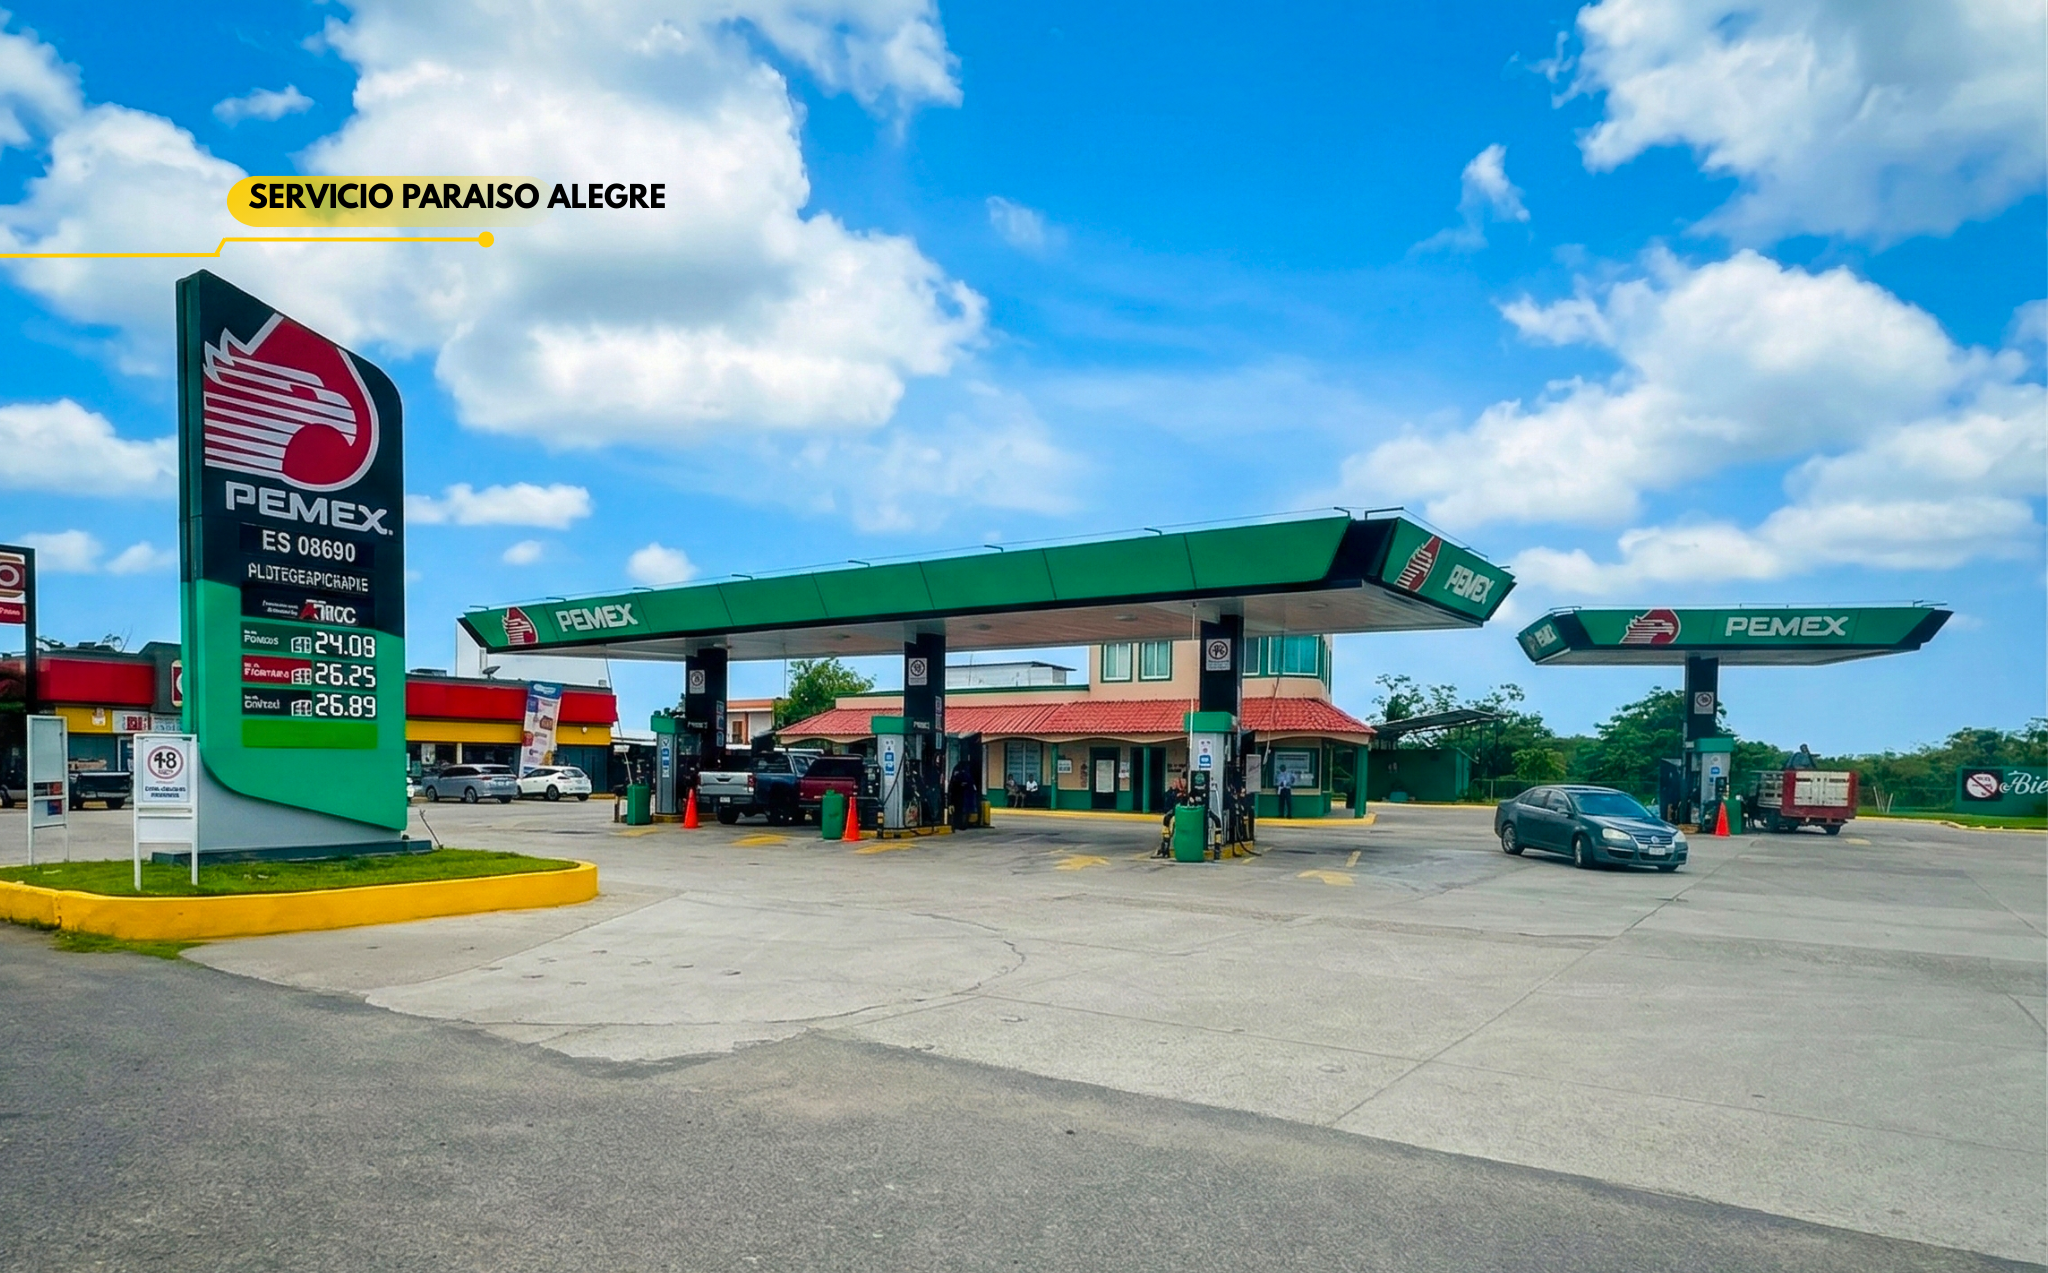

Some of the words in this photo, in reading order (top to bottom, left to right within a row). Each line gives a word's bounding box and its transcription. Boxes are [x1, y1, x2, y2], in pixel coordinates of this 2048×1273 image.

[225, 480, 388, 535] PEMEX
[262, 529, 291, 553] ES
[298, 536, 356, 562] 08690
[1443, 563, 1496, 605] PEMEX
[555, 602, 639, 633] PEMEX
[1725, 616, 1849, 637] PEMEX
[315, 631, 376, 658] 24.08
[315, 662, 376, 688] 26.25
[315, 693, 376, 718] 26.89
